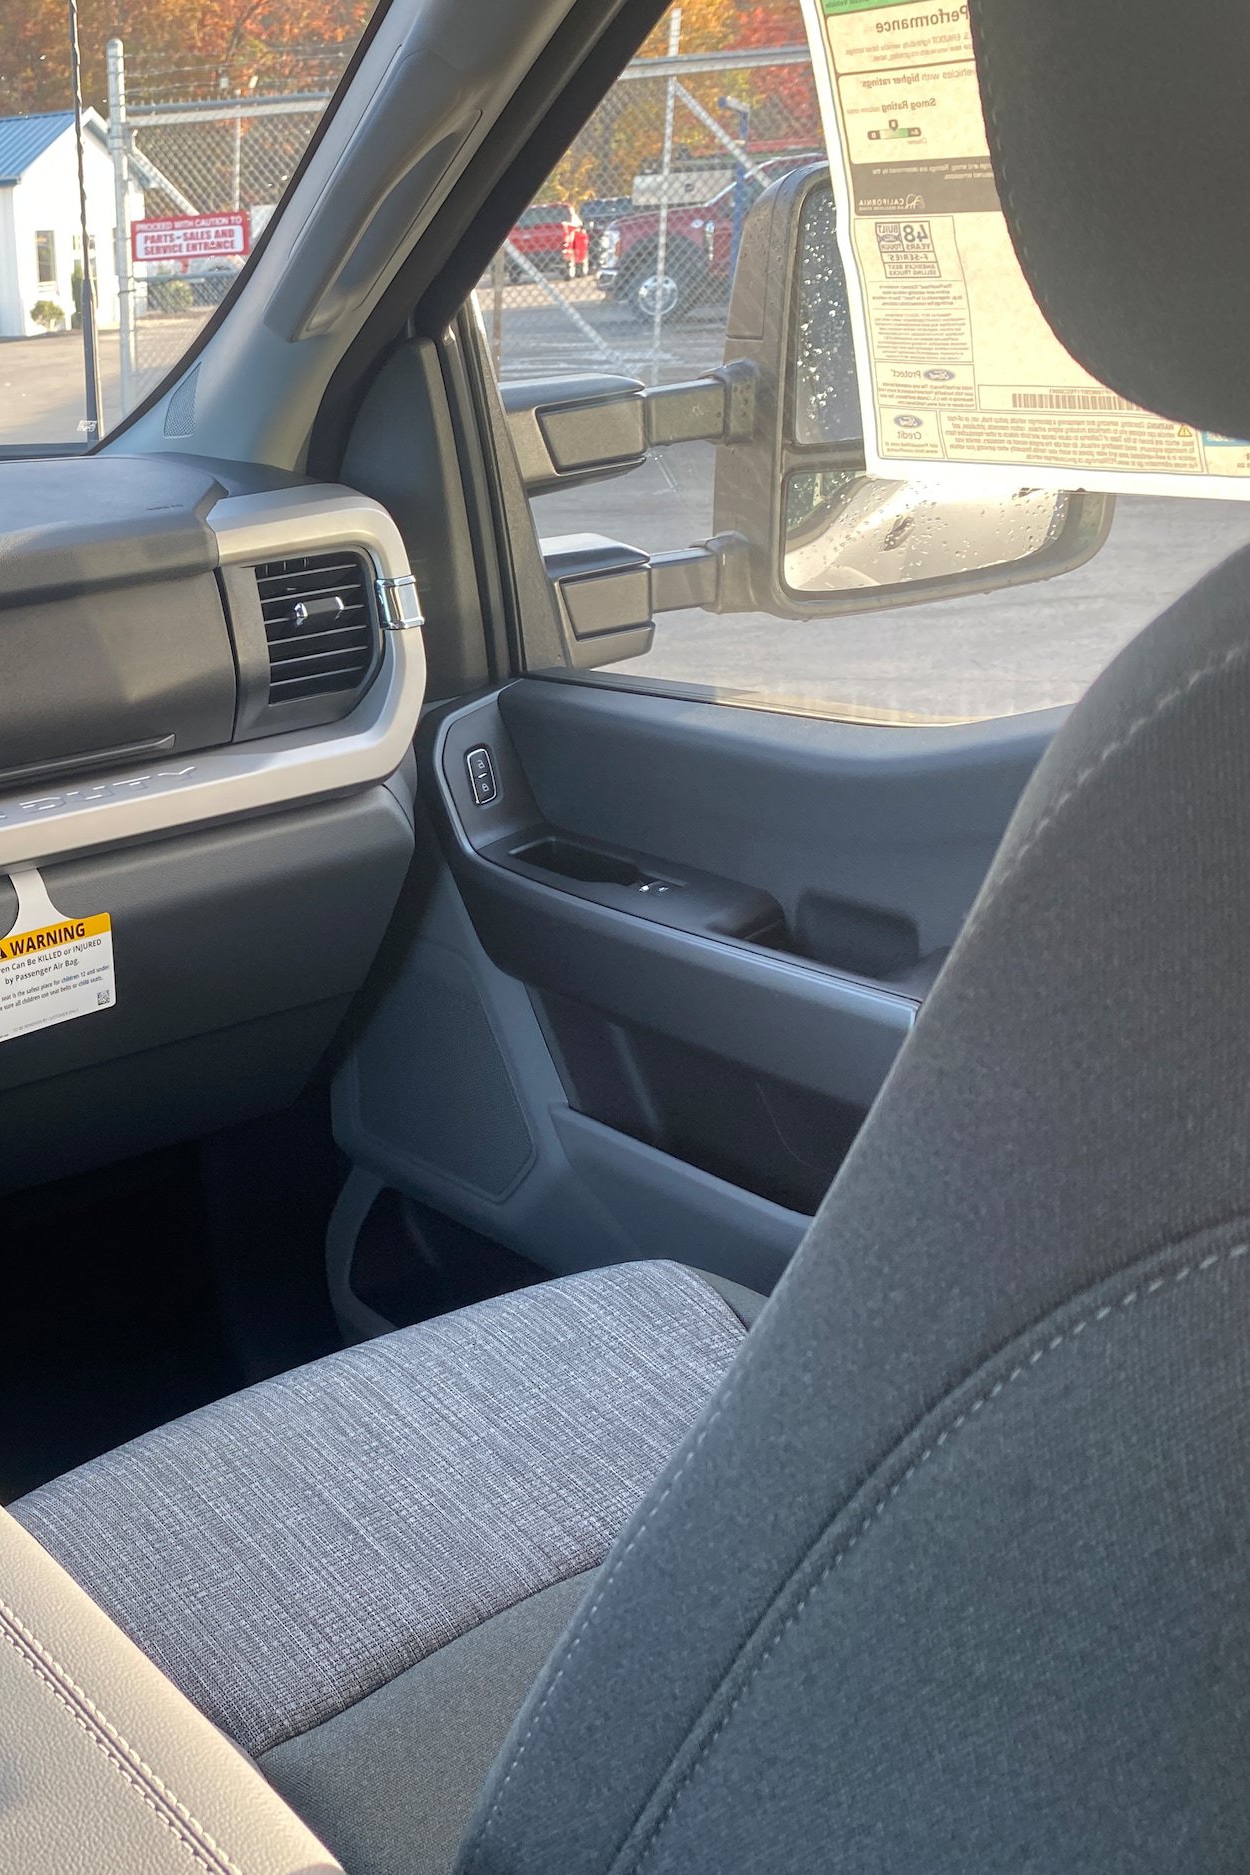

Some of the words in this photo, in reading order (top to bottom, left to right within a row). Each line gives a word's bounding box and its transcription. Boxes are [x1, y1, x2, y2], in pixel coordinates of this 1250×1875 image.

[230, 216, 242, 224] TO
[214, 229, 234, 238] AND
[144, 244, 183, 255] SERVICE
[186, 240, 235, 252] ENTRANCE
[18, 766, 197, 814] DUTY
[10, 923, 86, 956] WARNING
[12, 961, 26, 971] Can
[27, 957, 36, 967] Be
[37, 950, 62, 963] KILLED
[63, 949, 71, 957] or
[73, 939, 102, 954] INJURED
[4, 975, 13, 986] by
[15, 966, 52, 982] Passenger
[53, 961, 64, 972] Air
[17, 990, 25, 998] the
[61, 974, 80, 983] children
[87, 968, 96, 976] and
[96, 965, 110, 973] under
[21, 995, 41, 1005] children
